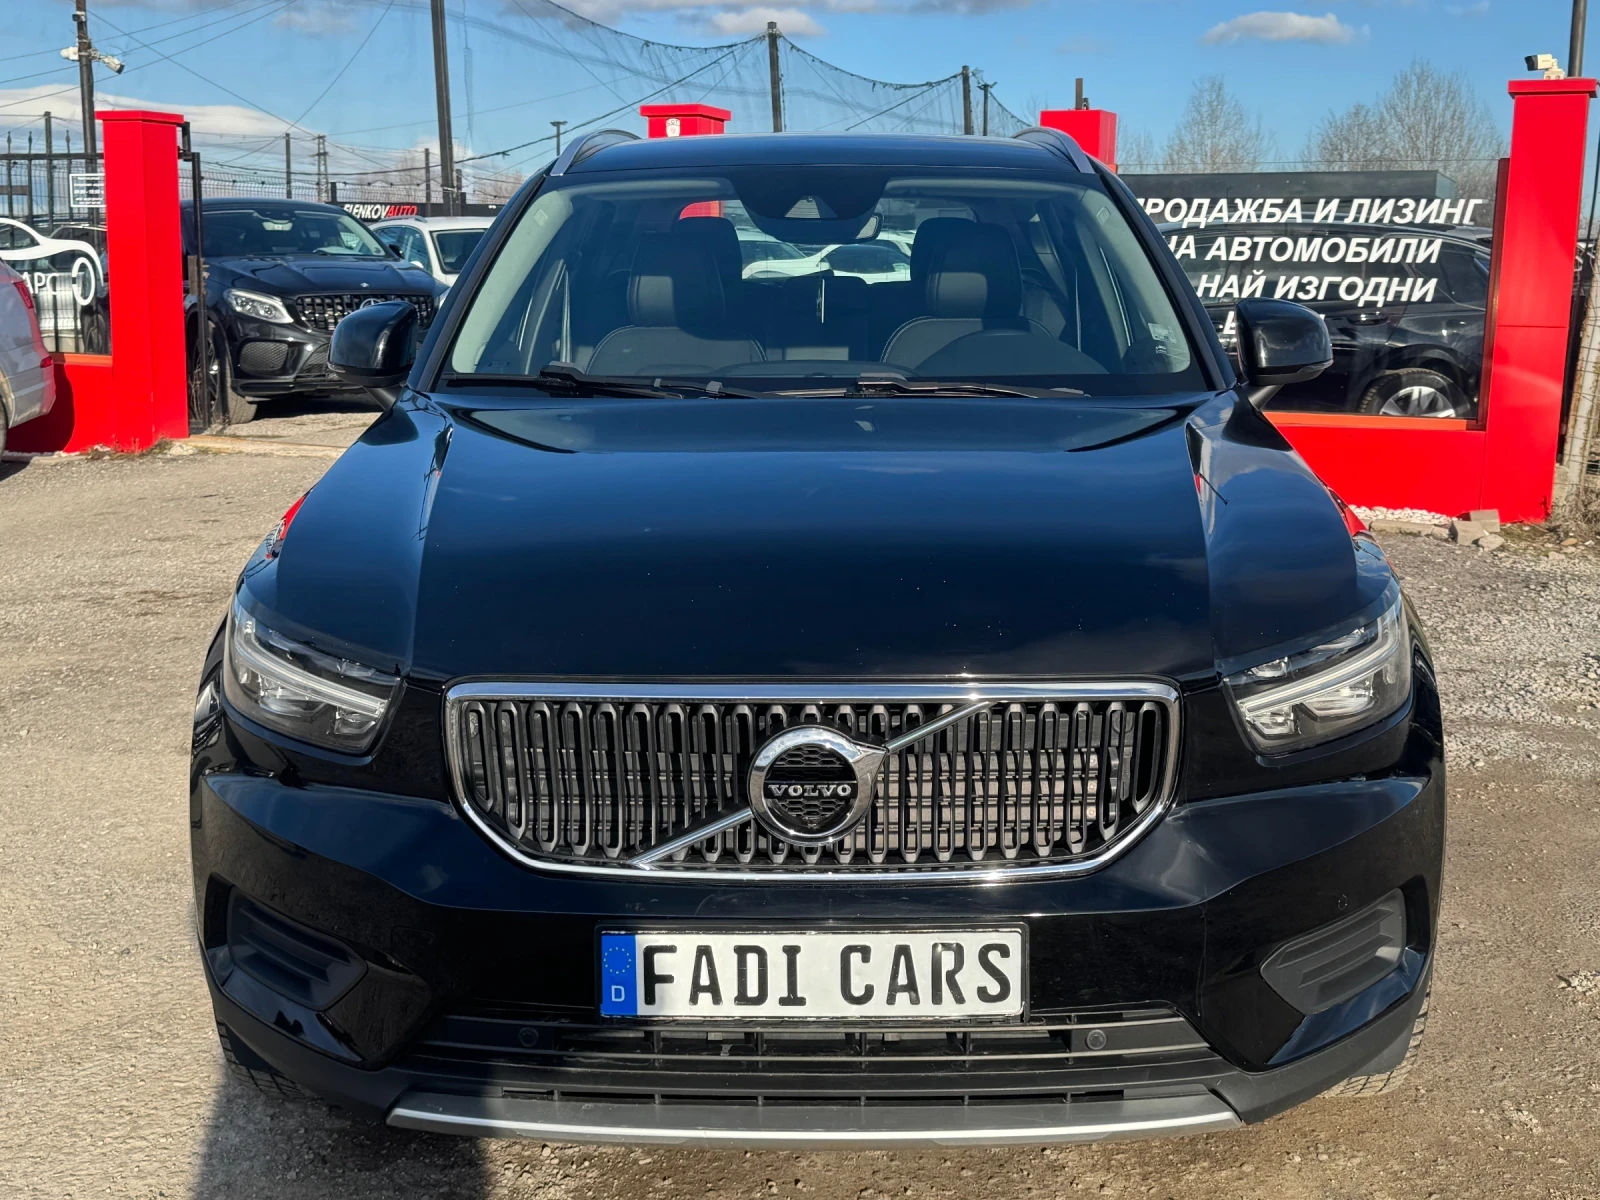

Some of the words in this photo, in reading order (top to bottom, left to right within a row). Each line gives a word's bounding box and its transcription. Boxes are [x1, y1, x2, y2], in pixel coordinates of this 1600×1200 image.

[1313, 198, 1340, 224] И
[1343, 198, 1483, 225] ЛИЗИНГ
[1204, 236, 1443, 264] АВТОМОБИЛИ
[1197, 269, 1267, 299] НАЙ
[1273, 275, 1439, 308] ИЗГОДНИ
[767, 784, 852, 798] VOLVO
[642, 944, 807, 1007] FADI
[839, 942, 1012, 1006] CARS
[610, 985, 626, 1003] D
